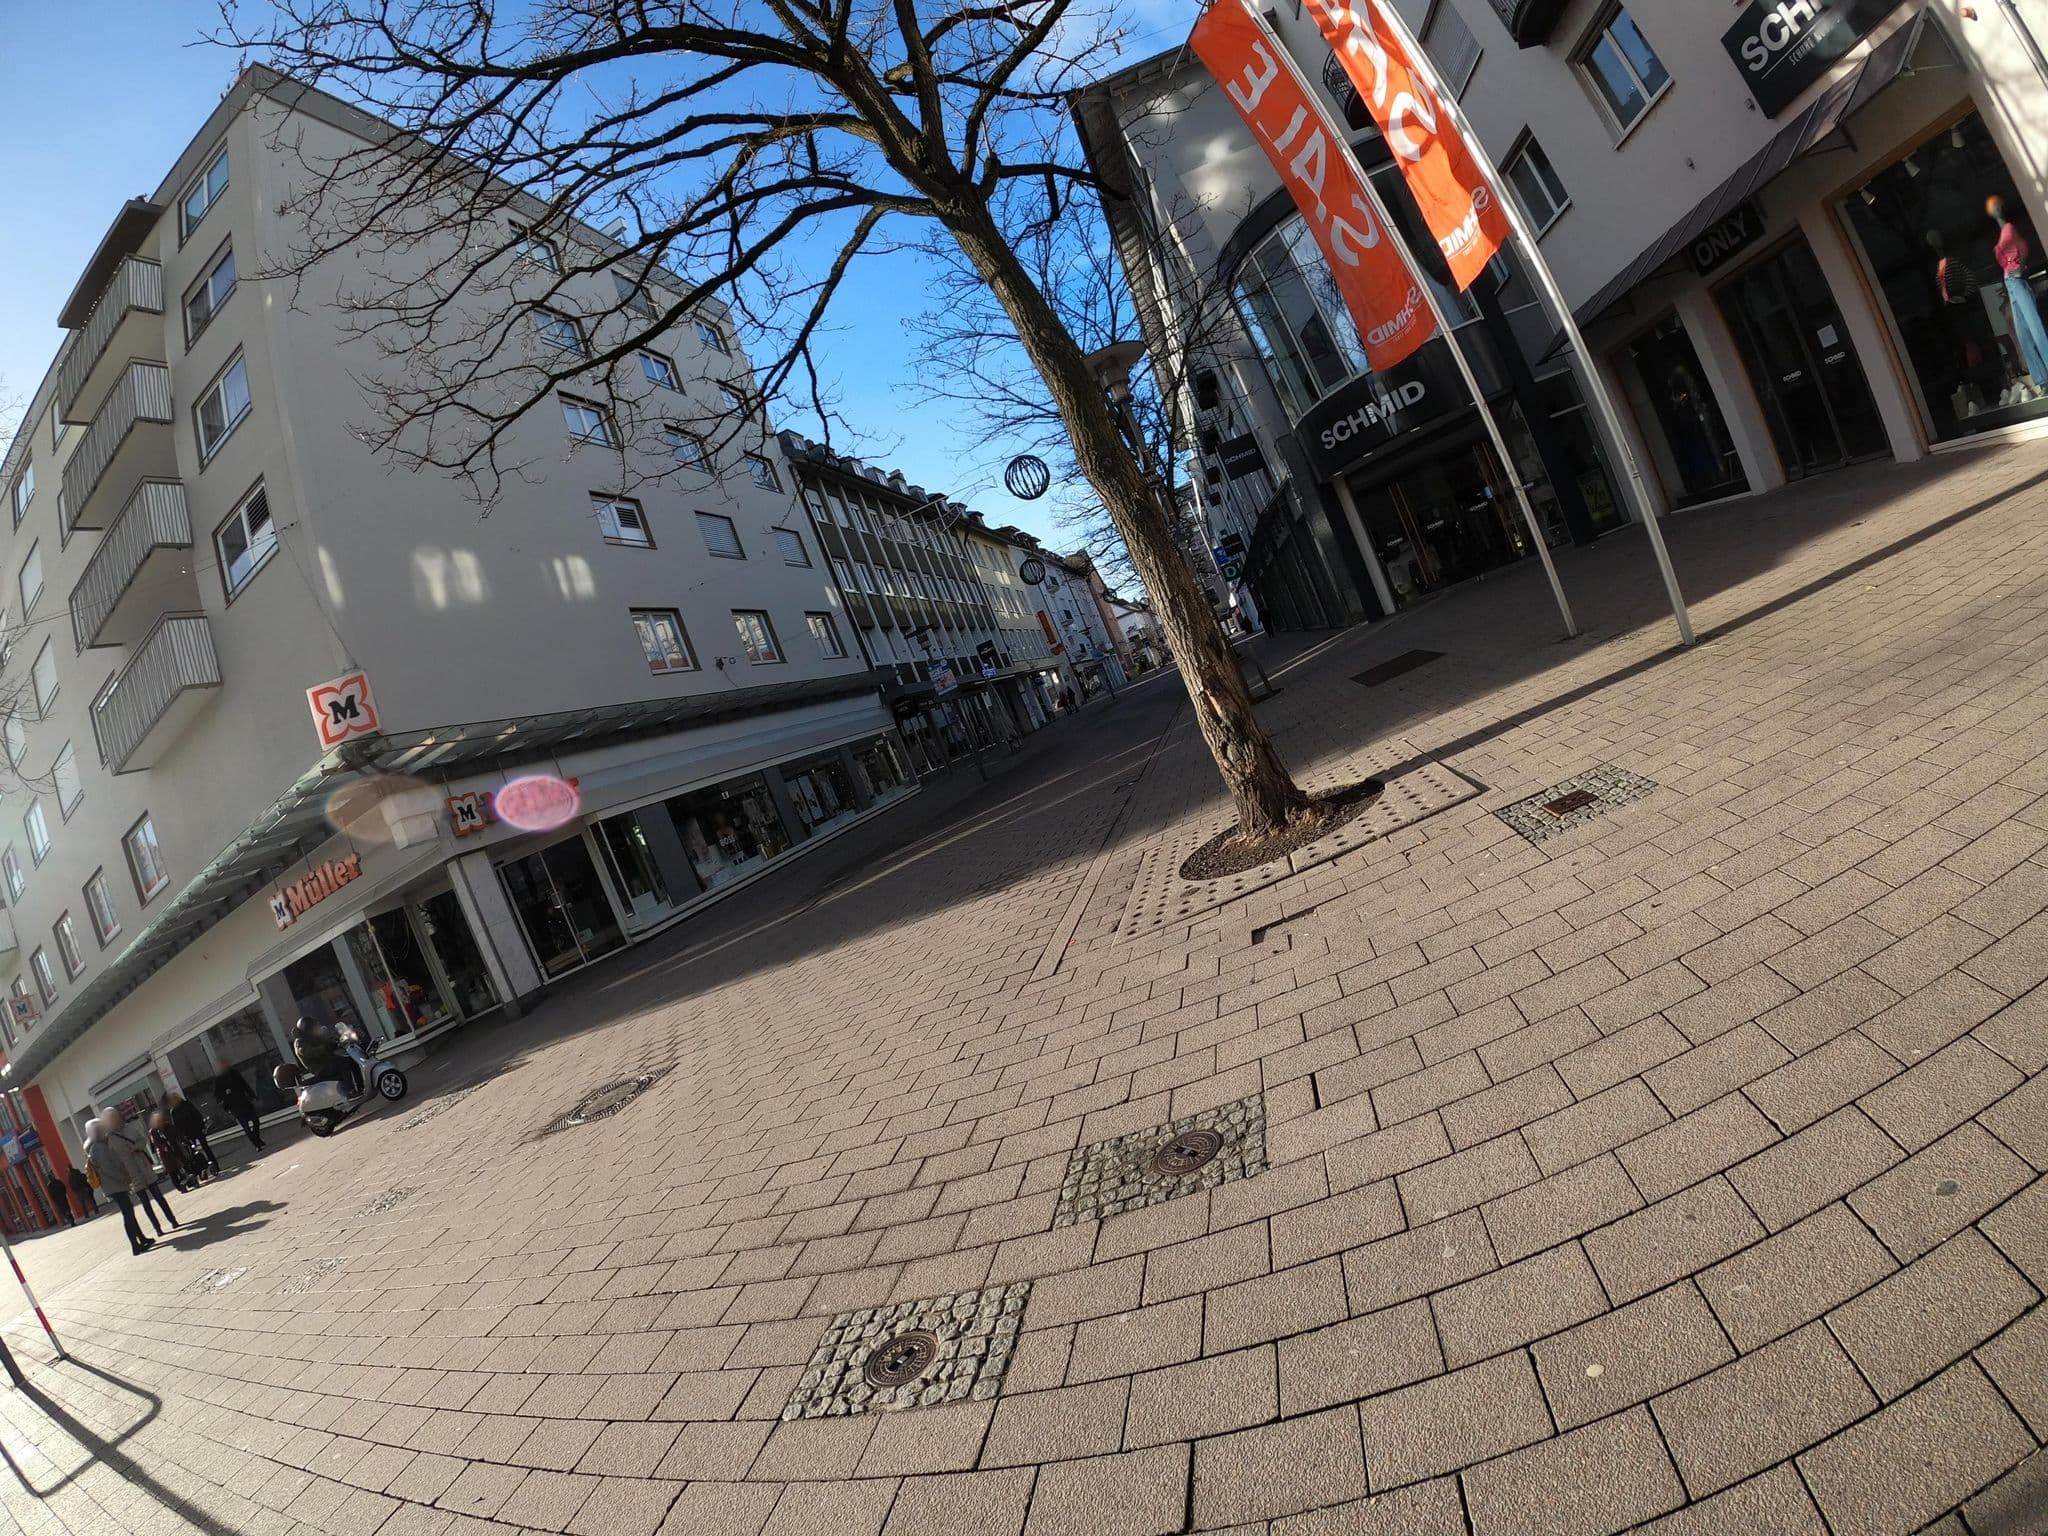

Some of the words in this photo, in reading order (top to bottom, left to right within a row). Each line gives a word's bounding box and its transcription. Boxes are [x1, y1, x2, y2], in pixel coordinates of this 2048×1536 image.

[1741, 0, 1823, 72] SCH
[1695, 210, 1747, 267] ONLY
[1320, 380, 1426, 450] SCHMID
[1223, 448, 1257, 465] SCHMID
[328, 695, 360, 725] M
[457, 804, 477, 823] M
[286, 851, 363, 914] Müller
